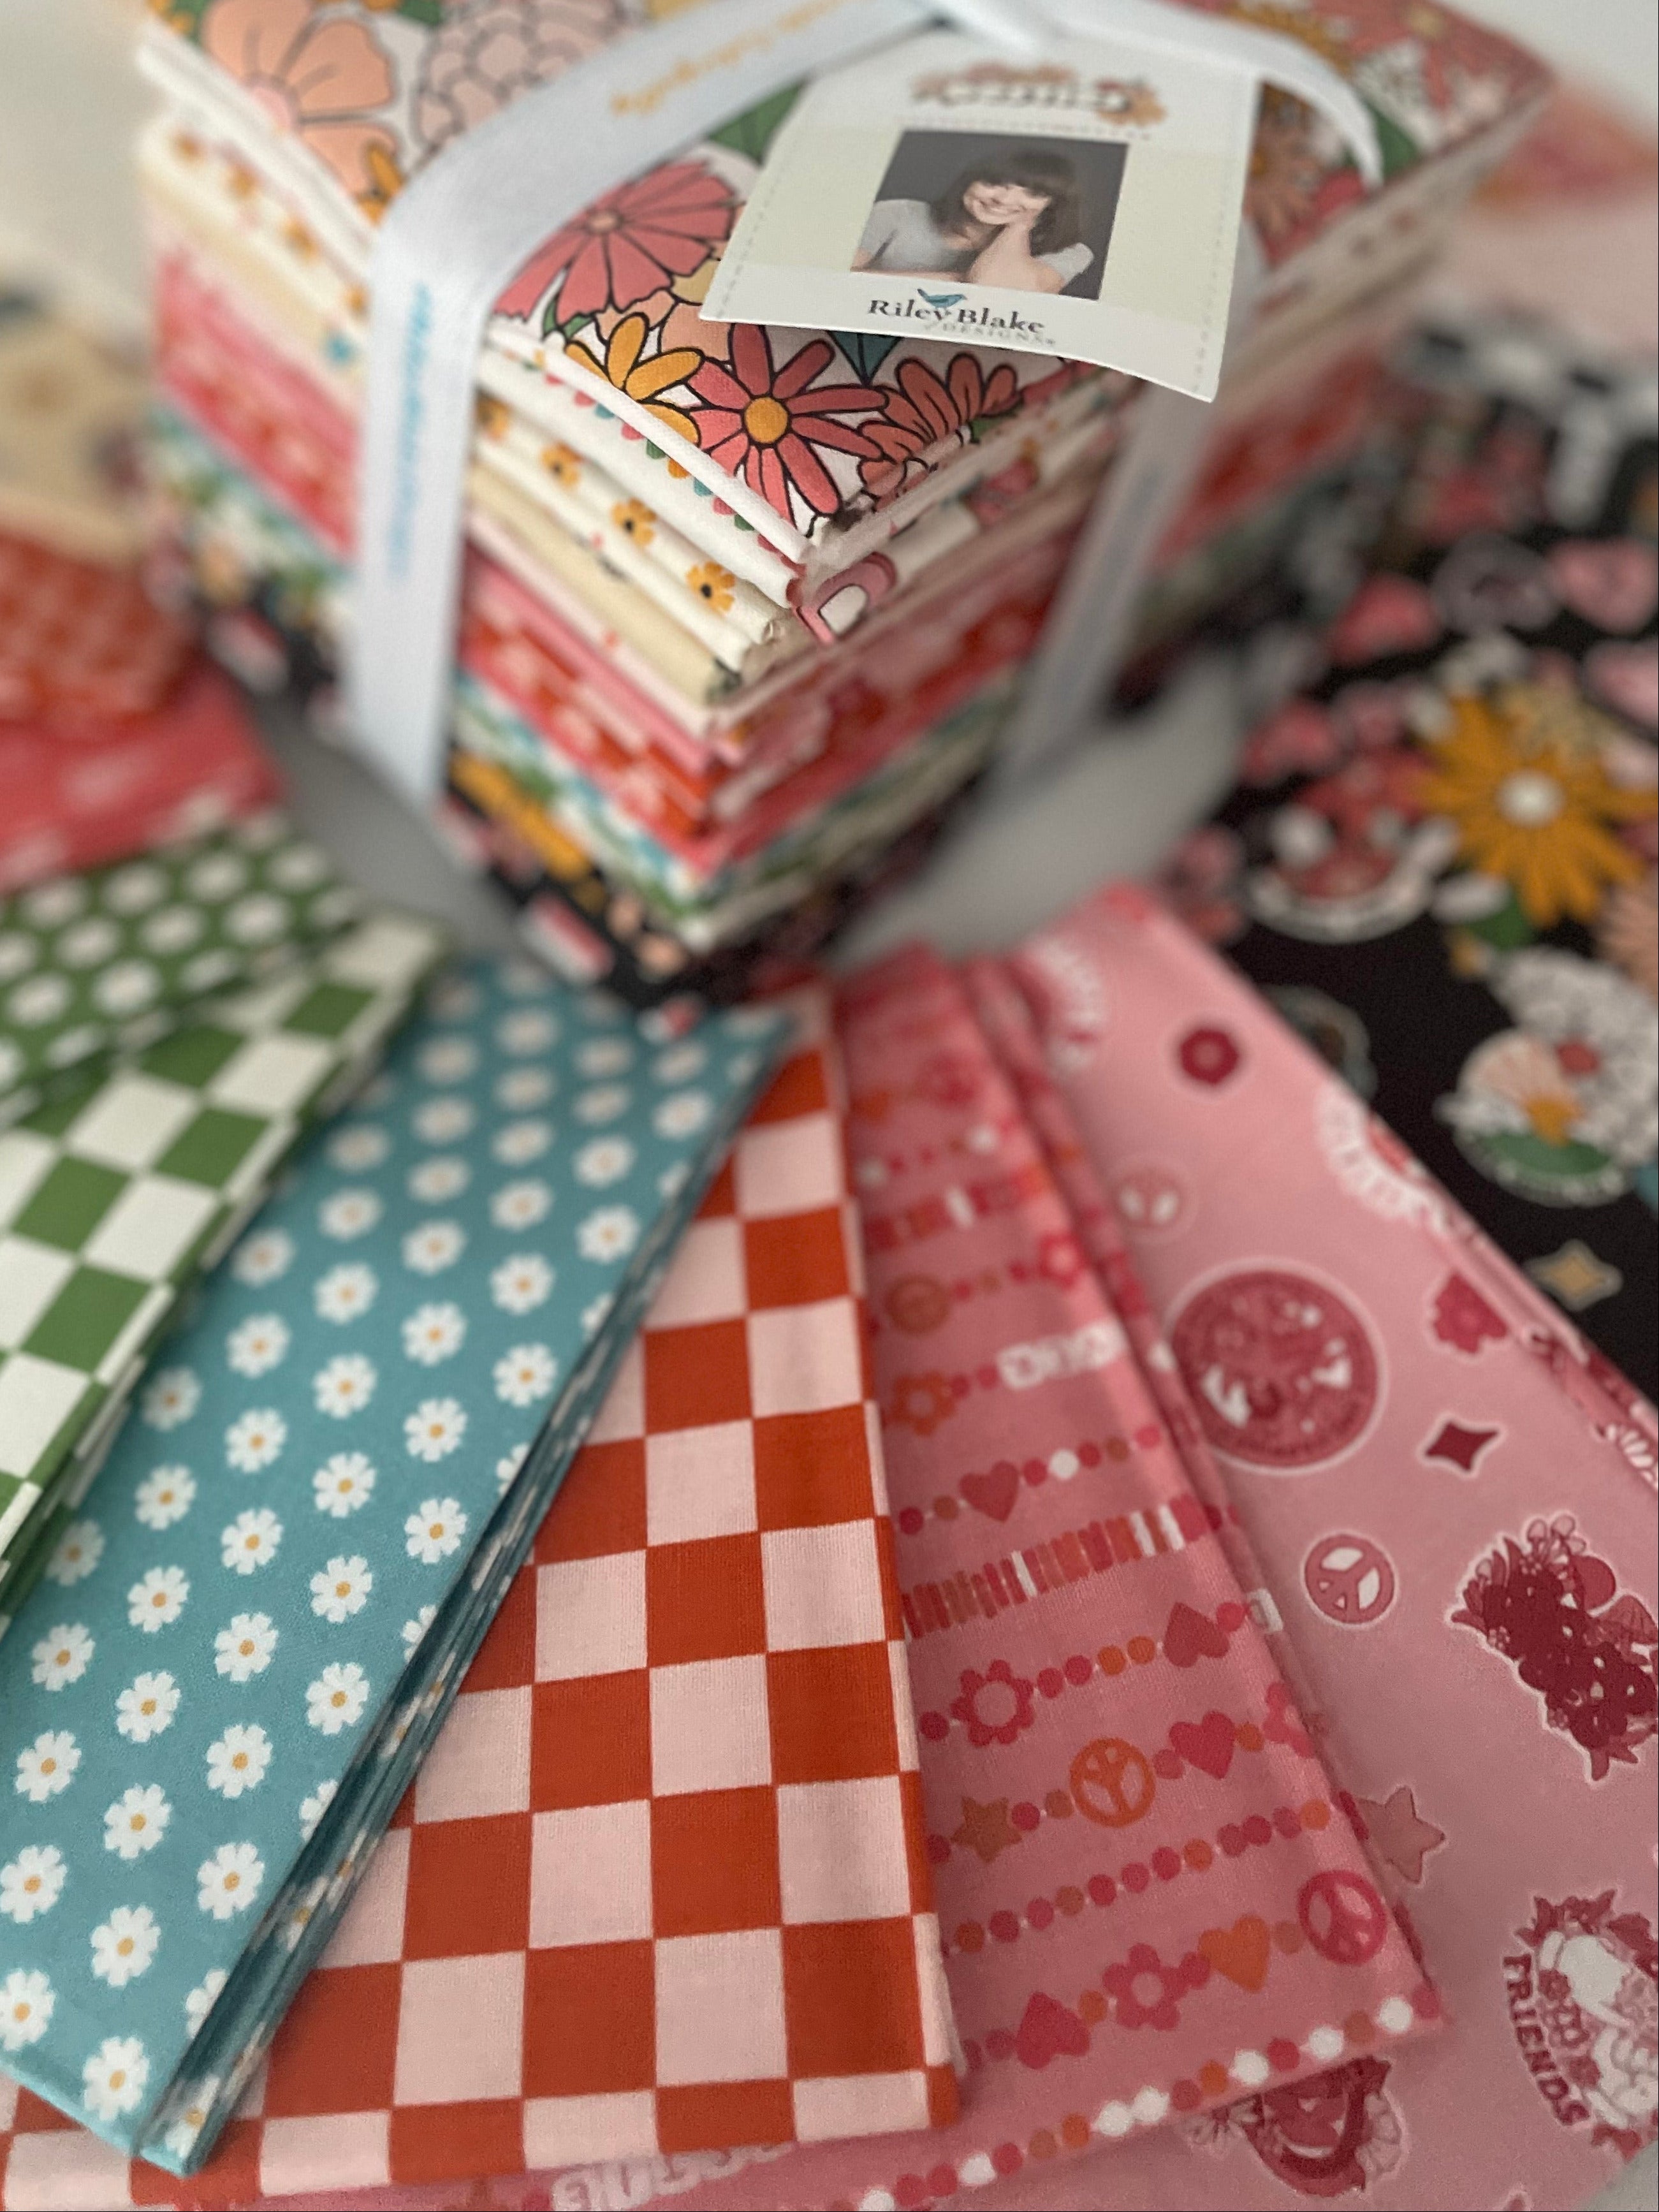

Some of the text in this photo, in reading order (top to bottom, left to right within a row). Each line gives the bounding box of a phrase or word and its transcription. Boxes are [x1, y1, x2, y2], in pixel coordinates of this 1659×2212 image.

[868, 298, 1044, 333] Riley Blake
[1503, 1952, 1590, 2127] FRIENDS
